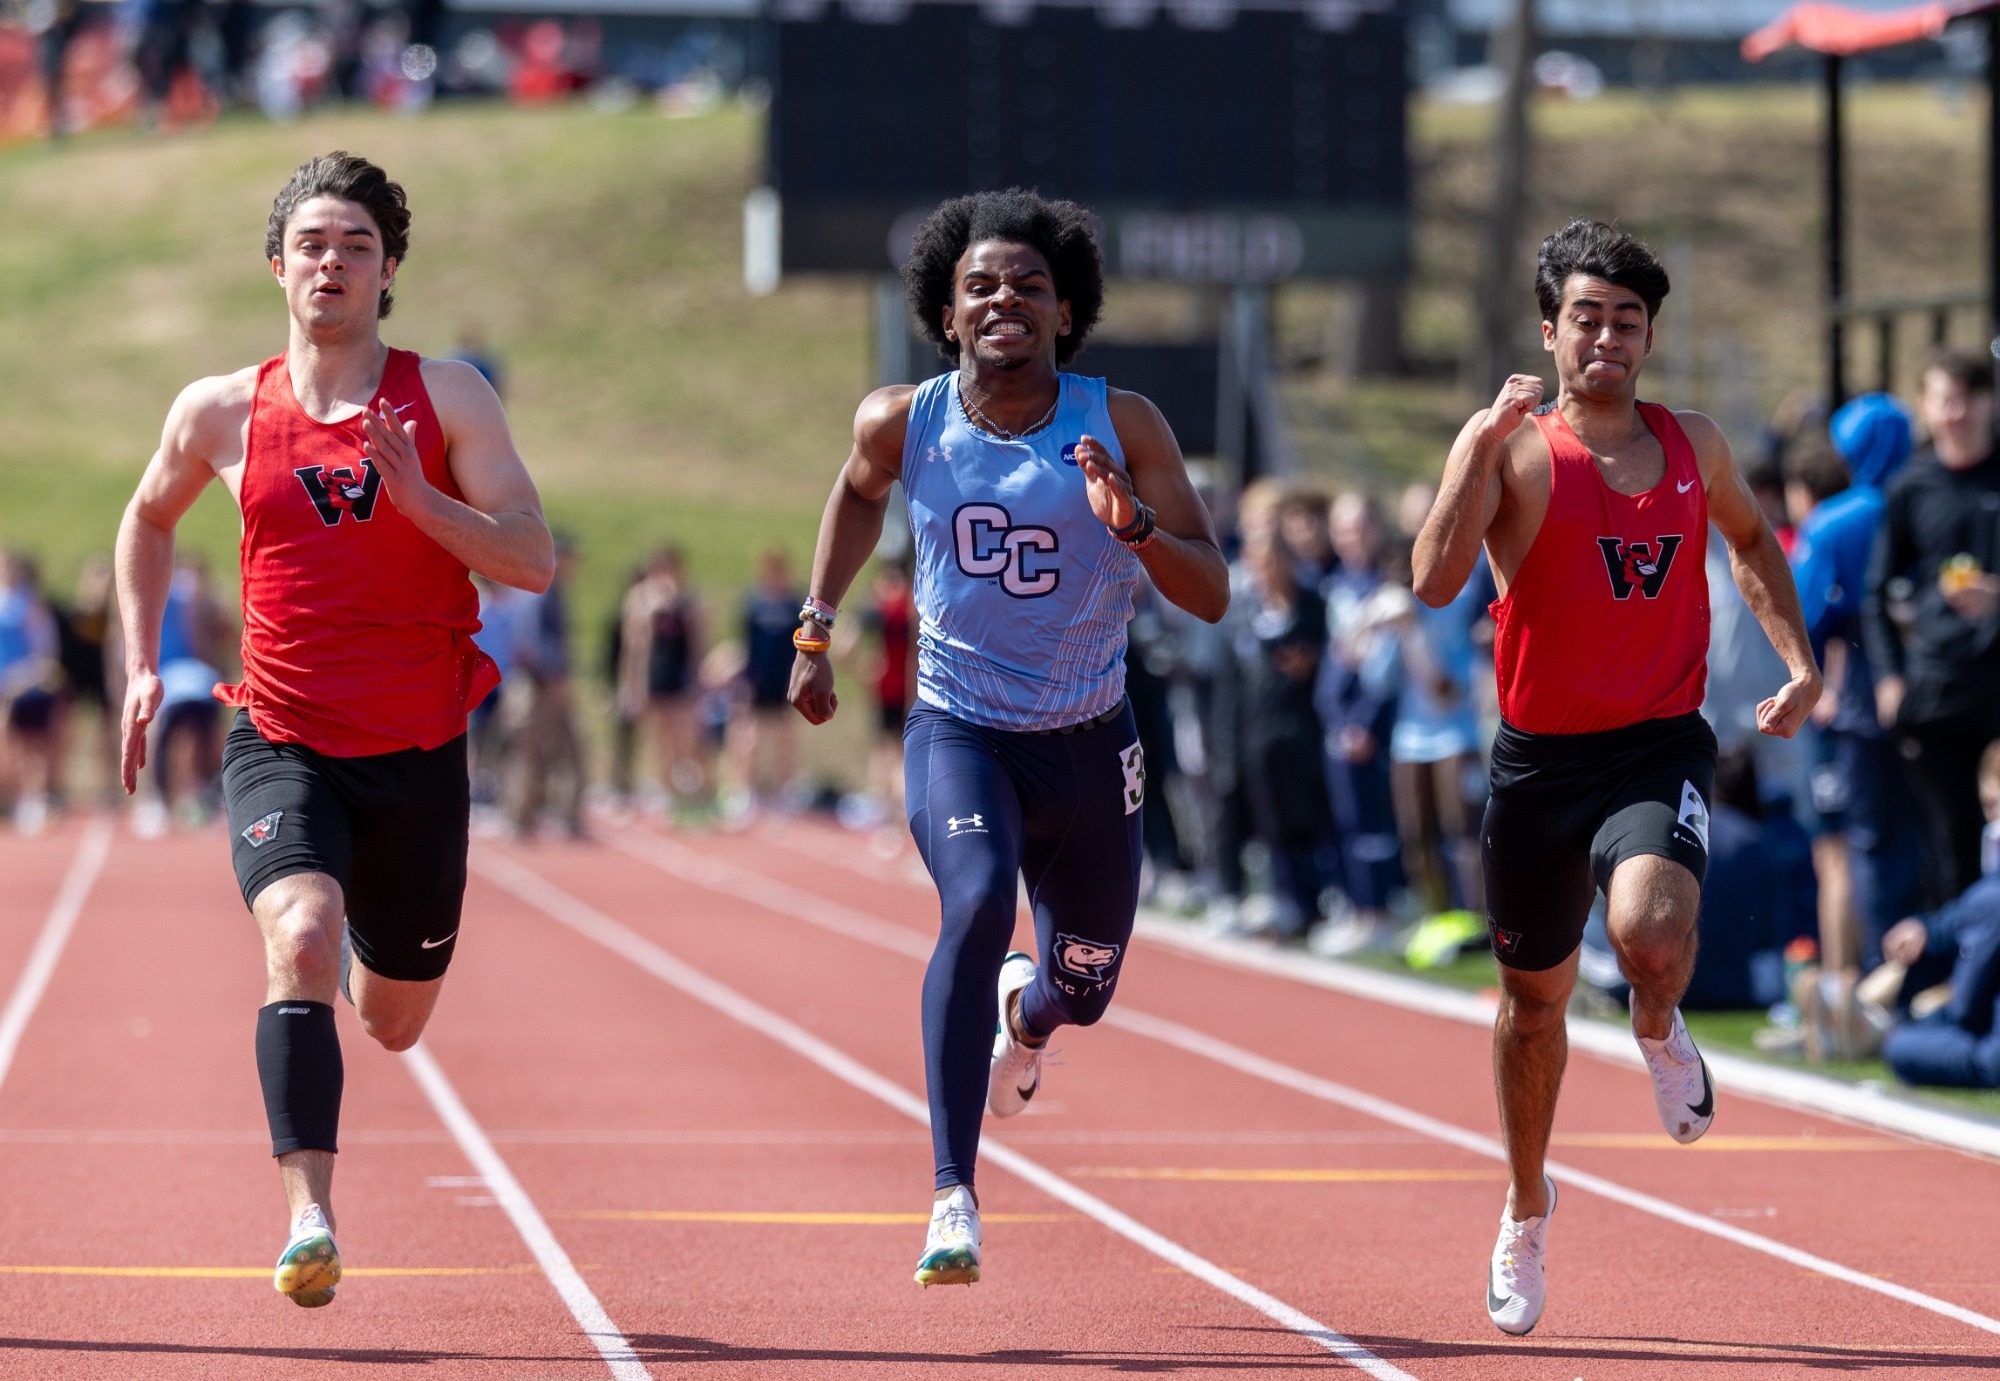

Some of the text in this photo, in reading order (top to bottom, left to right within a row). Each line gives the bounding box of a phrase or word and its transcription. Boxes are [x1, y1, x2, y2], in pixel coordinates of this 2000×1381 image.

[293, 457, 383, 527] W
[952, 502, 1060, 599] CC
[1597, 534, 1683, 600] W
[1127, 745, 1145, 806] 3
[1054, 976, 1076, 995] XC
